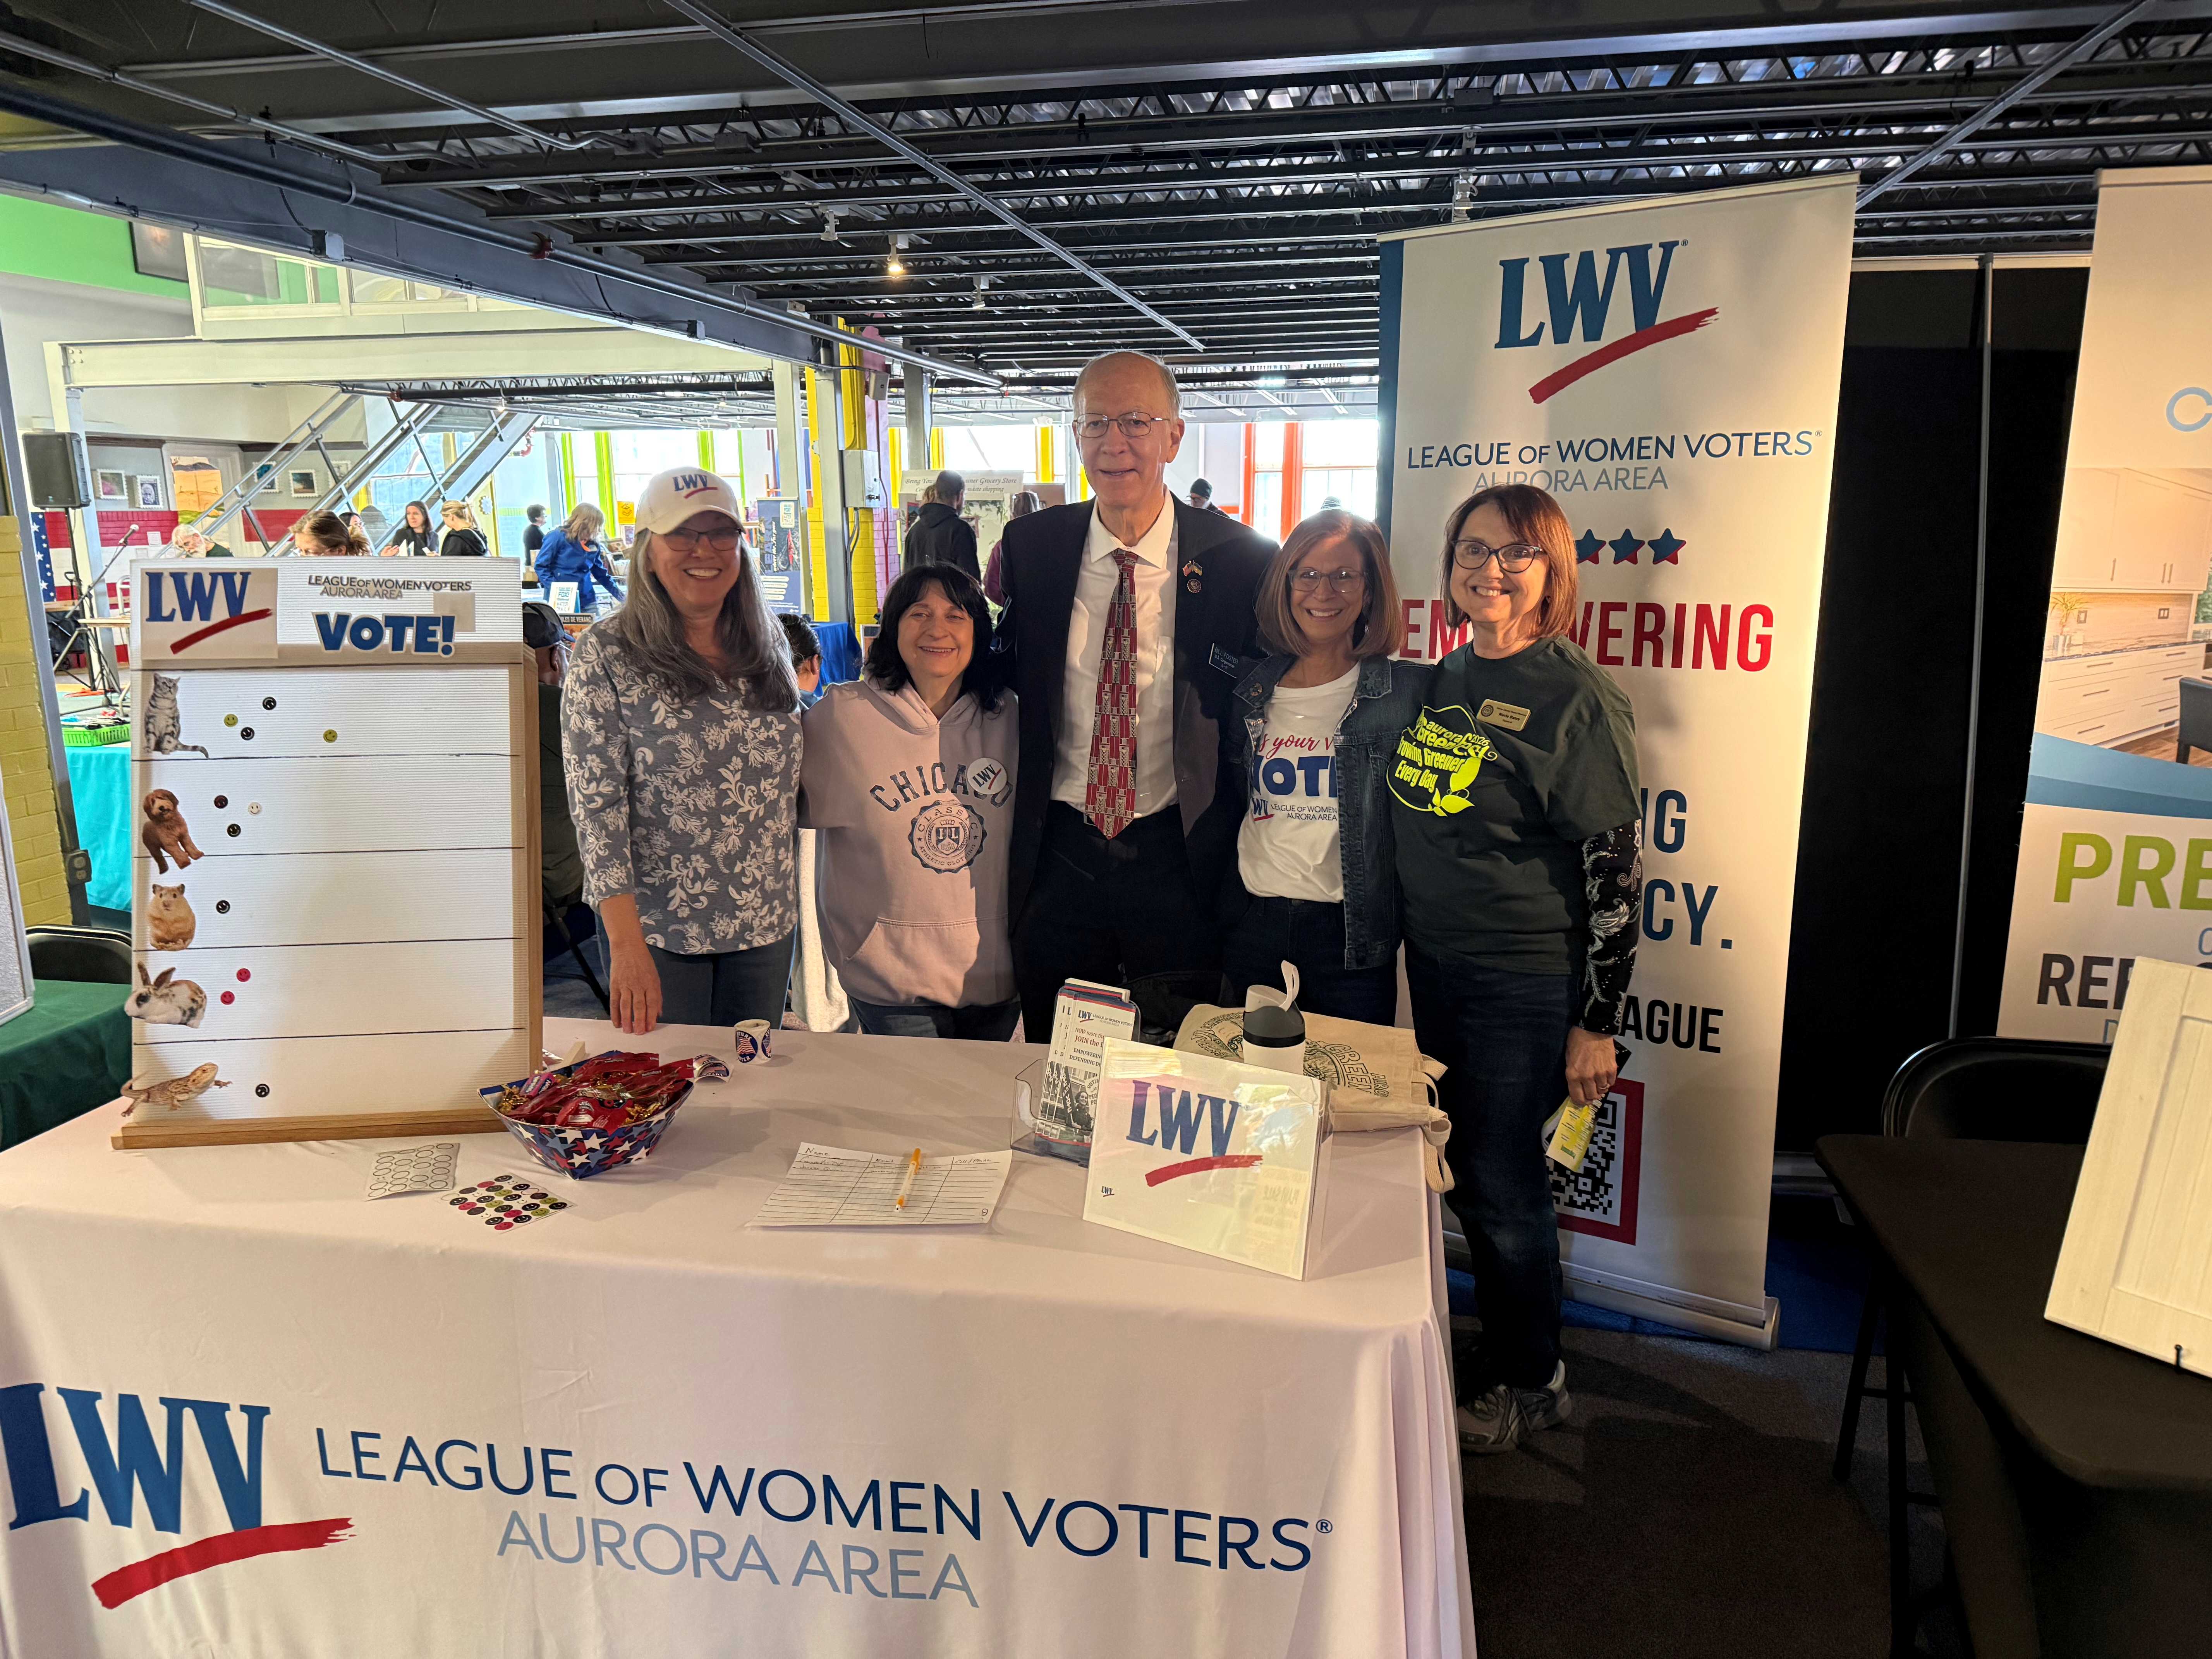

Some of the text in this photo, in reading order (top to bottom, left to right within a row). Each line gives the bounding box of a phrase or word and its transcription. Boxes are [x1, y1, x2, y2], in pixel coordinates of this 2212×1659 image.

[1408, 441, 1510, 469] LEAGUE
[1518, 445, 1551, 464] OF
[1556, 435, 1674, 463] WOMEN
[673, 474, 708, 491] LWV
[1593, 466, 1669, 491] AREA
[308, 575, 357, 587] LEAGUE
[357, 579, 371, 587] OF
[372, 578, 422, 590] WOMEN
[320, 586, 403, 599] AURORA AREA
[146, 572, 251, 622] LWV
[312, 611, 456, 658] VOTE!
[1266, 735, 1320, 760] your
[1472, 734, 1491, 746] 2026
[1423, 747, 1466, 773] Greener
[972, 764, 996, 787] LWV
[1395, 759, 1439, 793] Every Day
[918, 807, 978, 832] CLASSIC
[919, 846, 945, 866] ATHLETIC
[1078, 1010, 1092, 1020] LWV
[1075, 1027, 1086, 1035] NOW
[1075, 1035, 1089, 1044] JOIN
[1090, 1038, 1099, 1047] the
[1069, 1054, 1095, 1065] DEFENDING
[1126, 1079, 1240, 1158] LWV
[1101, 1186, 1113, 1194] LWV
[0, 1383, 270, 1534] LWV
[316, 1427, 577, 1499] LEAGUE
[596, 1464, 669, 1508] OF
[682, 1461, 982, 1541] WOMEN
[497, 1510, 979, 1608] AURORA AREA
